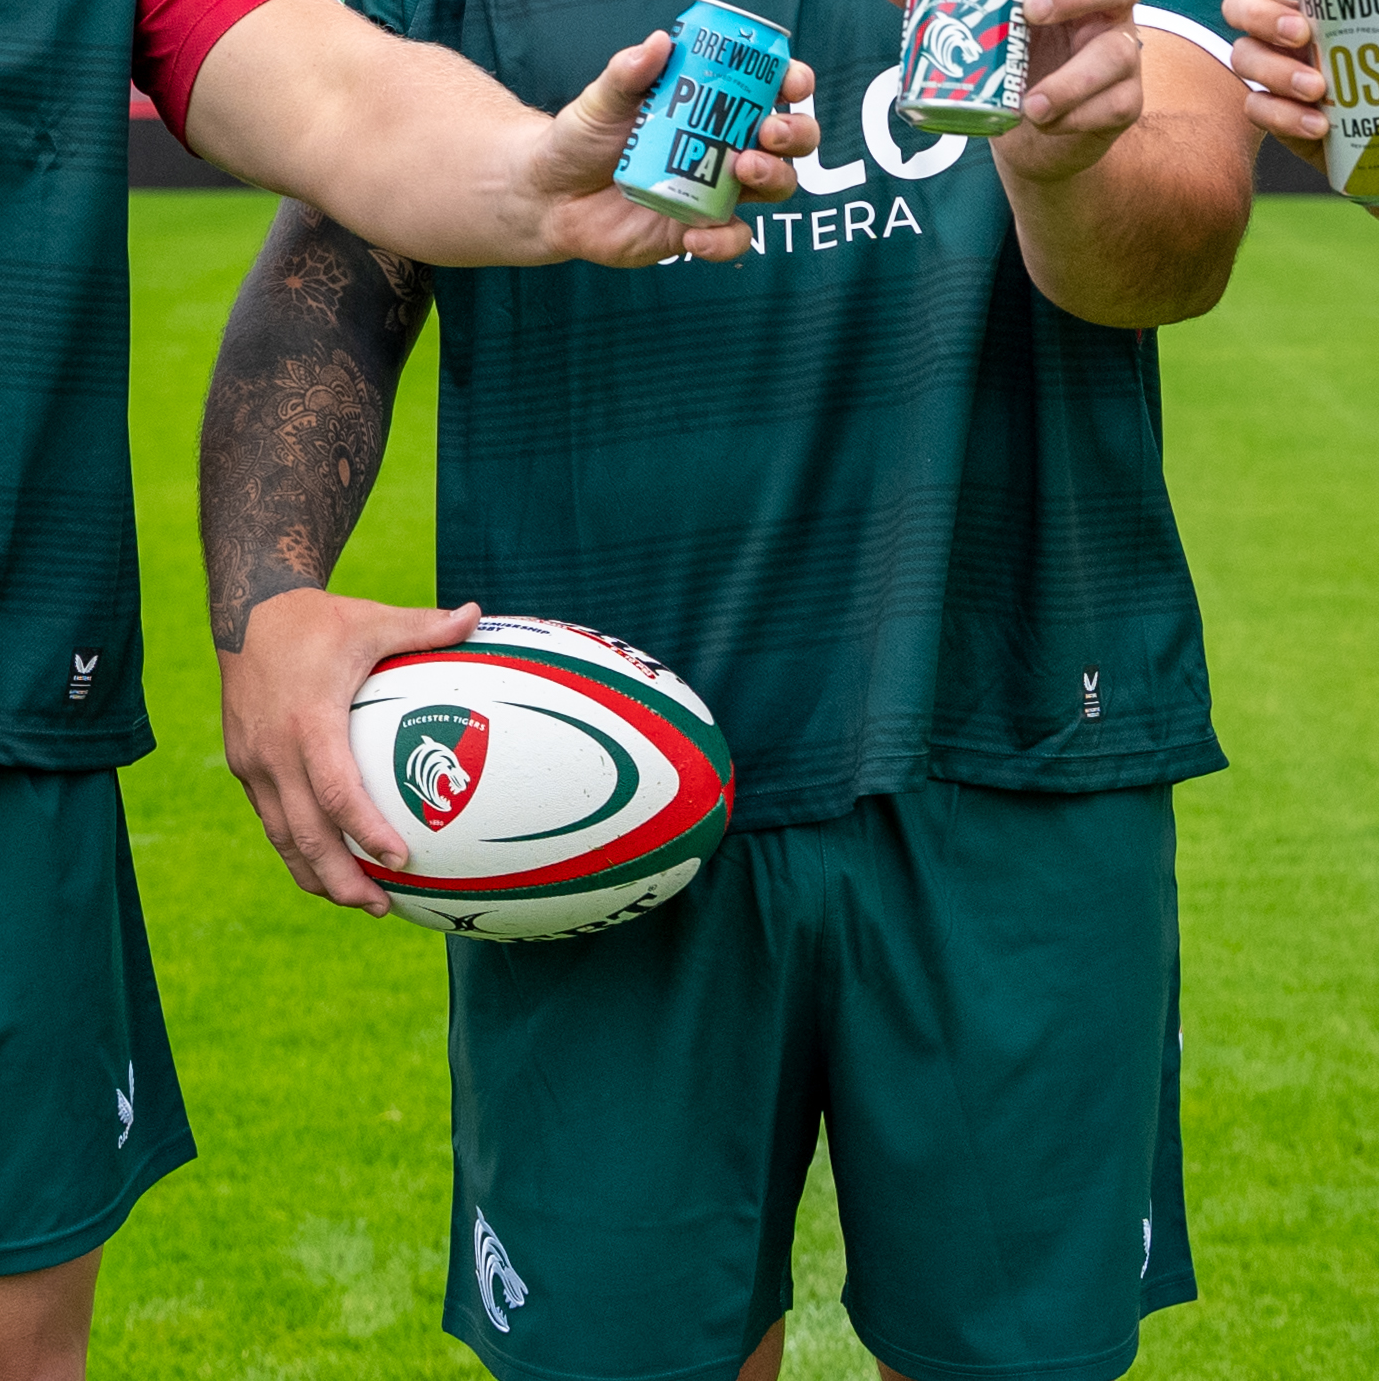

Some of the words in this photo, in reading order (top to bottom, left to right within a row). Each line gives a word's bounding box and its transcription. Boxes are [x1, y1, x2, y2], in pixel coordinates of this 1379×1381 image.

[691, 27, 780, 85] BREWDOG
[665, 74, 764, 152] PUNK
[780, 64, 969, 196] LO
[669, 131, 721, 185] IPA
[402, 714, 450, 728] LEICESTER
[453, 715, 486, 731] TIGERS
